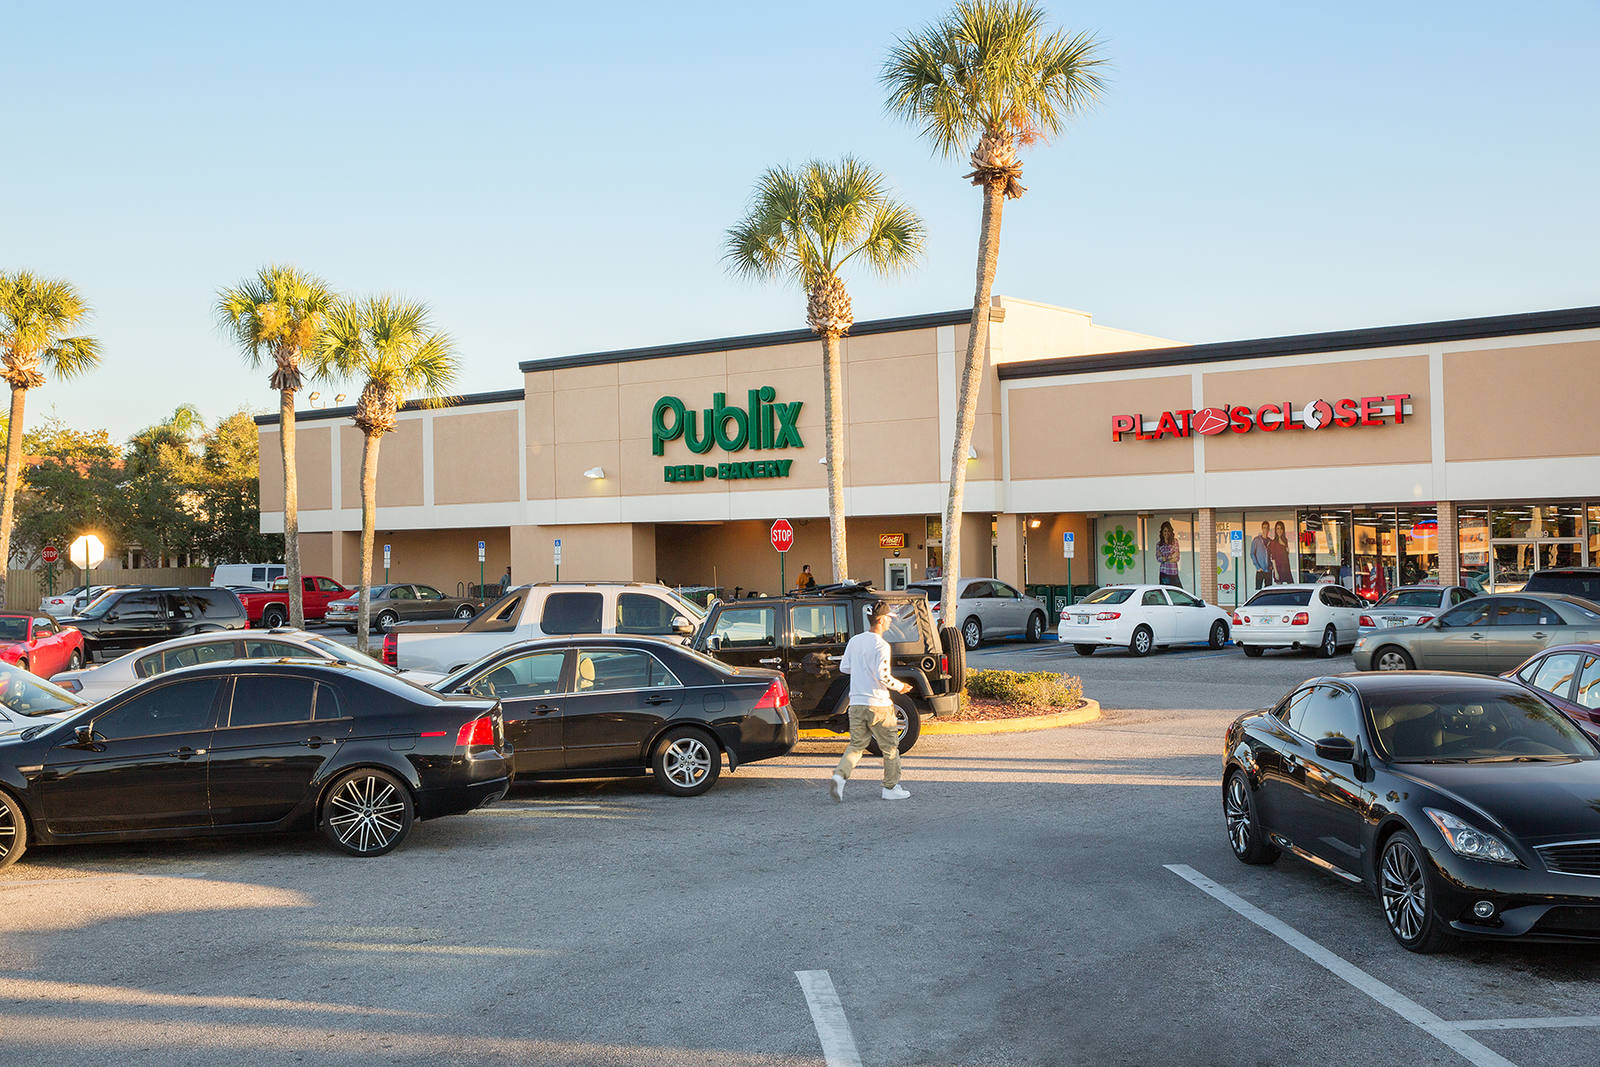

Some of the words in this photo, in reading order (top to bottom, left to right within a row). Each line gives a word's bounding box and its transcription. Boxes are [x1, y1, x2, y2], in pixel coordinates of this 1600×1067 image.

[652, 386, 805, 456] Publix
[1112, 404, 1254, 442] PLATO'S
[1255, 394, 1412, 431] CLOSET
[664, 464, 705, 482] DELI
[718, 459, 793, 480] BAKERY
[773, 530, 791, 542] STOP
[43, 550, 57, 558] STOP
